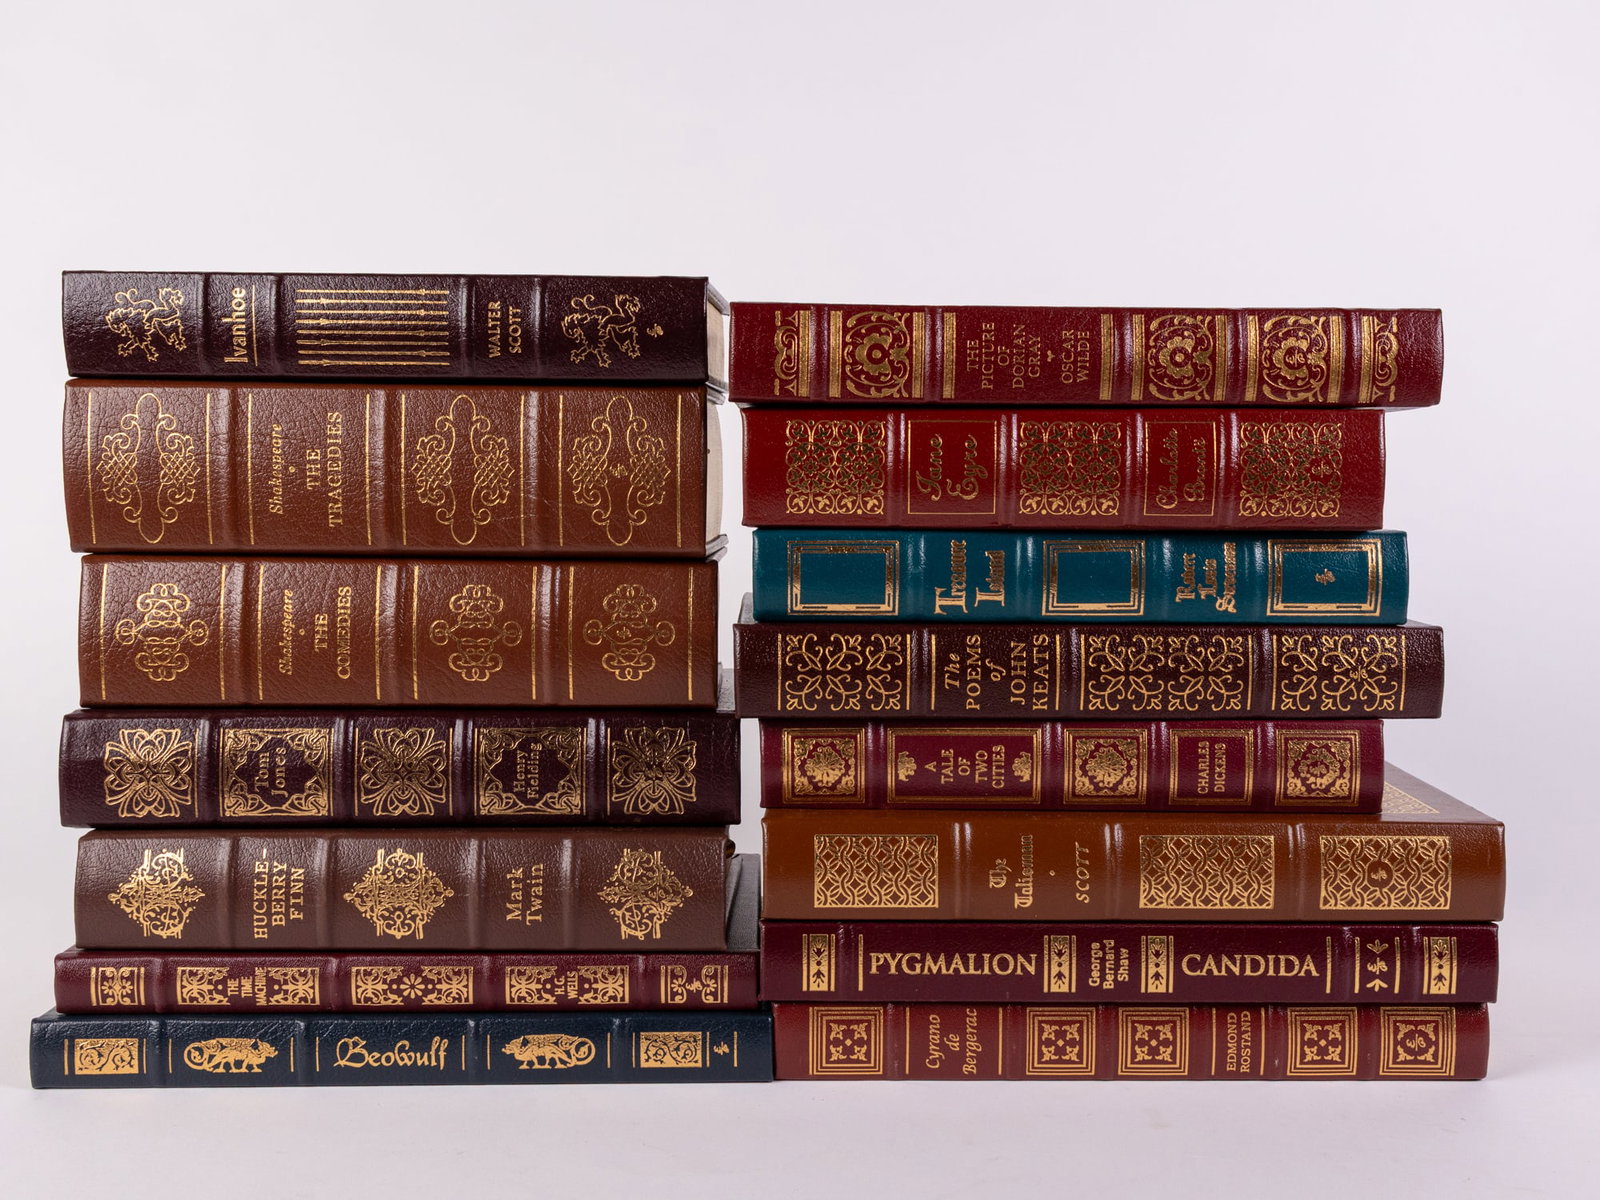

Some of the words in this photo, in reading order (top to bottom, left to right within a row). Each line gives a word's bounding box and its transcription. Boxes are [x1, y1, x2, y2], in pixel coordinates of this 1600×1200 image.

[222, 286, 248, 364] Ivanhoe
[488, 301, 501, 359] WALTER
[508, 306, 521, 354] SCOTT
[967, 339, 978, 372] THE
[982, 322, 995, 390] PICTURE
[997, 345, 1009, 366] OF
[1012, 324, 1025, 389] DORIAN
[1028, 334, 1041, 378] GRAY
[1061, 329, 1074, 384] OSCAR
[1076, 330, 1089, 383] WILDE
[270, 424, 282, 515] Shakespeare
[307, 450, 319, 490] THE
[327, 412, 342, 528] TRAGEDIES
[915, 433, 943, 501] Jane
[946, 434, 988, 500] Eyre
[934, 540, 968, 615] Treasure
[279, 589, 293, 675] Shakespeare
[314, 613, 327, 652] THE
[338, 586, 351, 680] COMEDIES
[944, 652, 960, 690] The
[966, 634, 981, 710] POEMS
[986, 659, 1006, 682] of
[1010, 641, 1026, 705] JOHN
[1033, 634, 1048, 711] KEATS
[255, 752, 270, 792] Tom
[270, 746, 287, 799] Jones
[513, 750, 529, 792] Henry
[527, 742, 541, 799] Fielding
[925, 761, 937, 772] A
[941, 748, 953, 784] TALE
[958, 757, 970, 776] OF
[975, 750, 988, 783] TWO
[992, 744, 1005, 789] CITIES
[1198, 741, 1210, 794] CHARLES
[1214, 743, 1226, 792] DICKENS
[253, 847, 269, 939] HUCKLE-
[272, 861, 287, 927] BERRY
[290, 867, 305, 921] FINN
[505, 866, 521, 922] Mark
[526, 863, 542, 926] Twain
[990, 858, 1012, 888] The
[1014, 834, 1033, 909] Talisman
[1075, 841, 1089, 903] SCOTT
[228, 977, 239, 997] THE
[241, 975, 252, 998] TIME
[255, 966, 266, 1006] MACHINE
[567, 970, 578, 1000] WELLS
[869, 953, 1036, 975] PYGMALION
[1089, 942, 1103, 986] George
[1103, 940, 1115, 989] Bernard
[1117, 948, 1129, 982] Shaw
[1182, 954, 1319, 977] CANDIDA
[333, 1036, 446, 1071] Beowulf
[926, 1014, 945, 1069] Cyrano
[944, 1033, 960, 1051] de
[962, 1008, 981, 1074] Bergerac
[1227, 1012, 1238, 1071] EDMOND
[1240, 1011, 1251, 1072] ROSTAND
